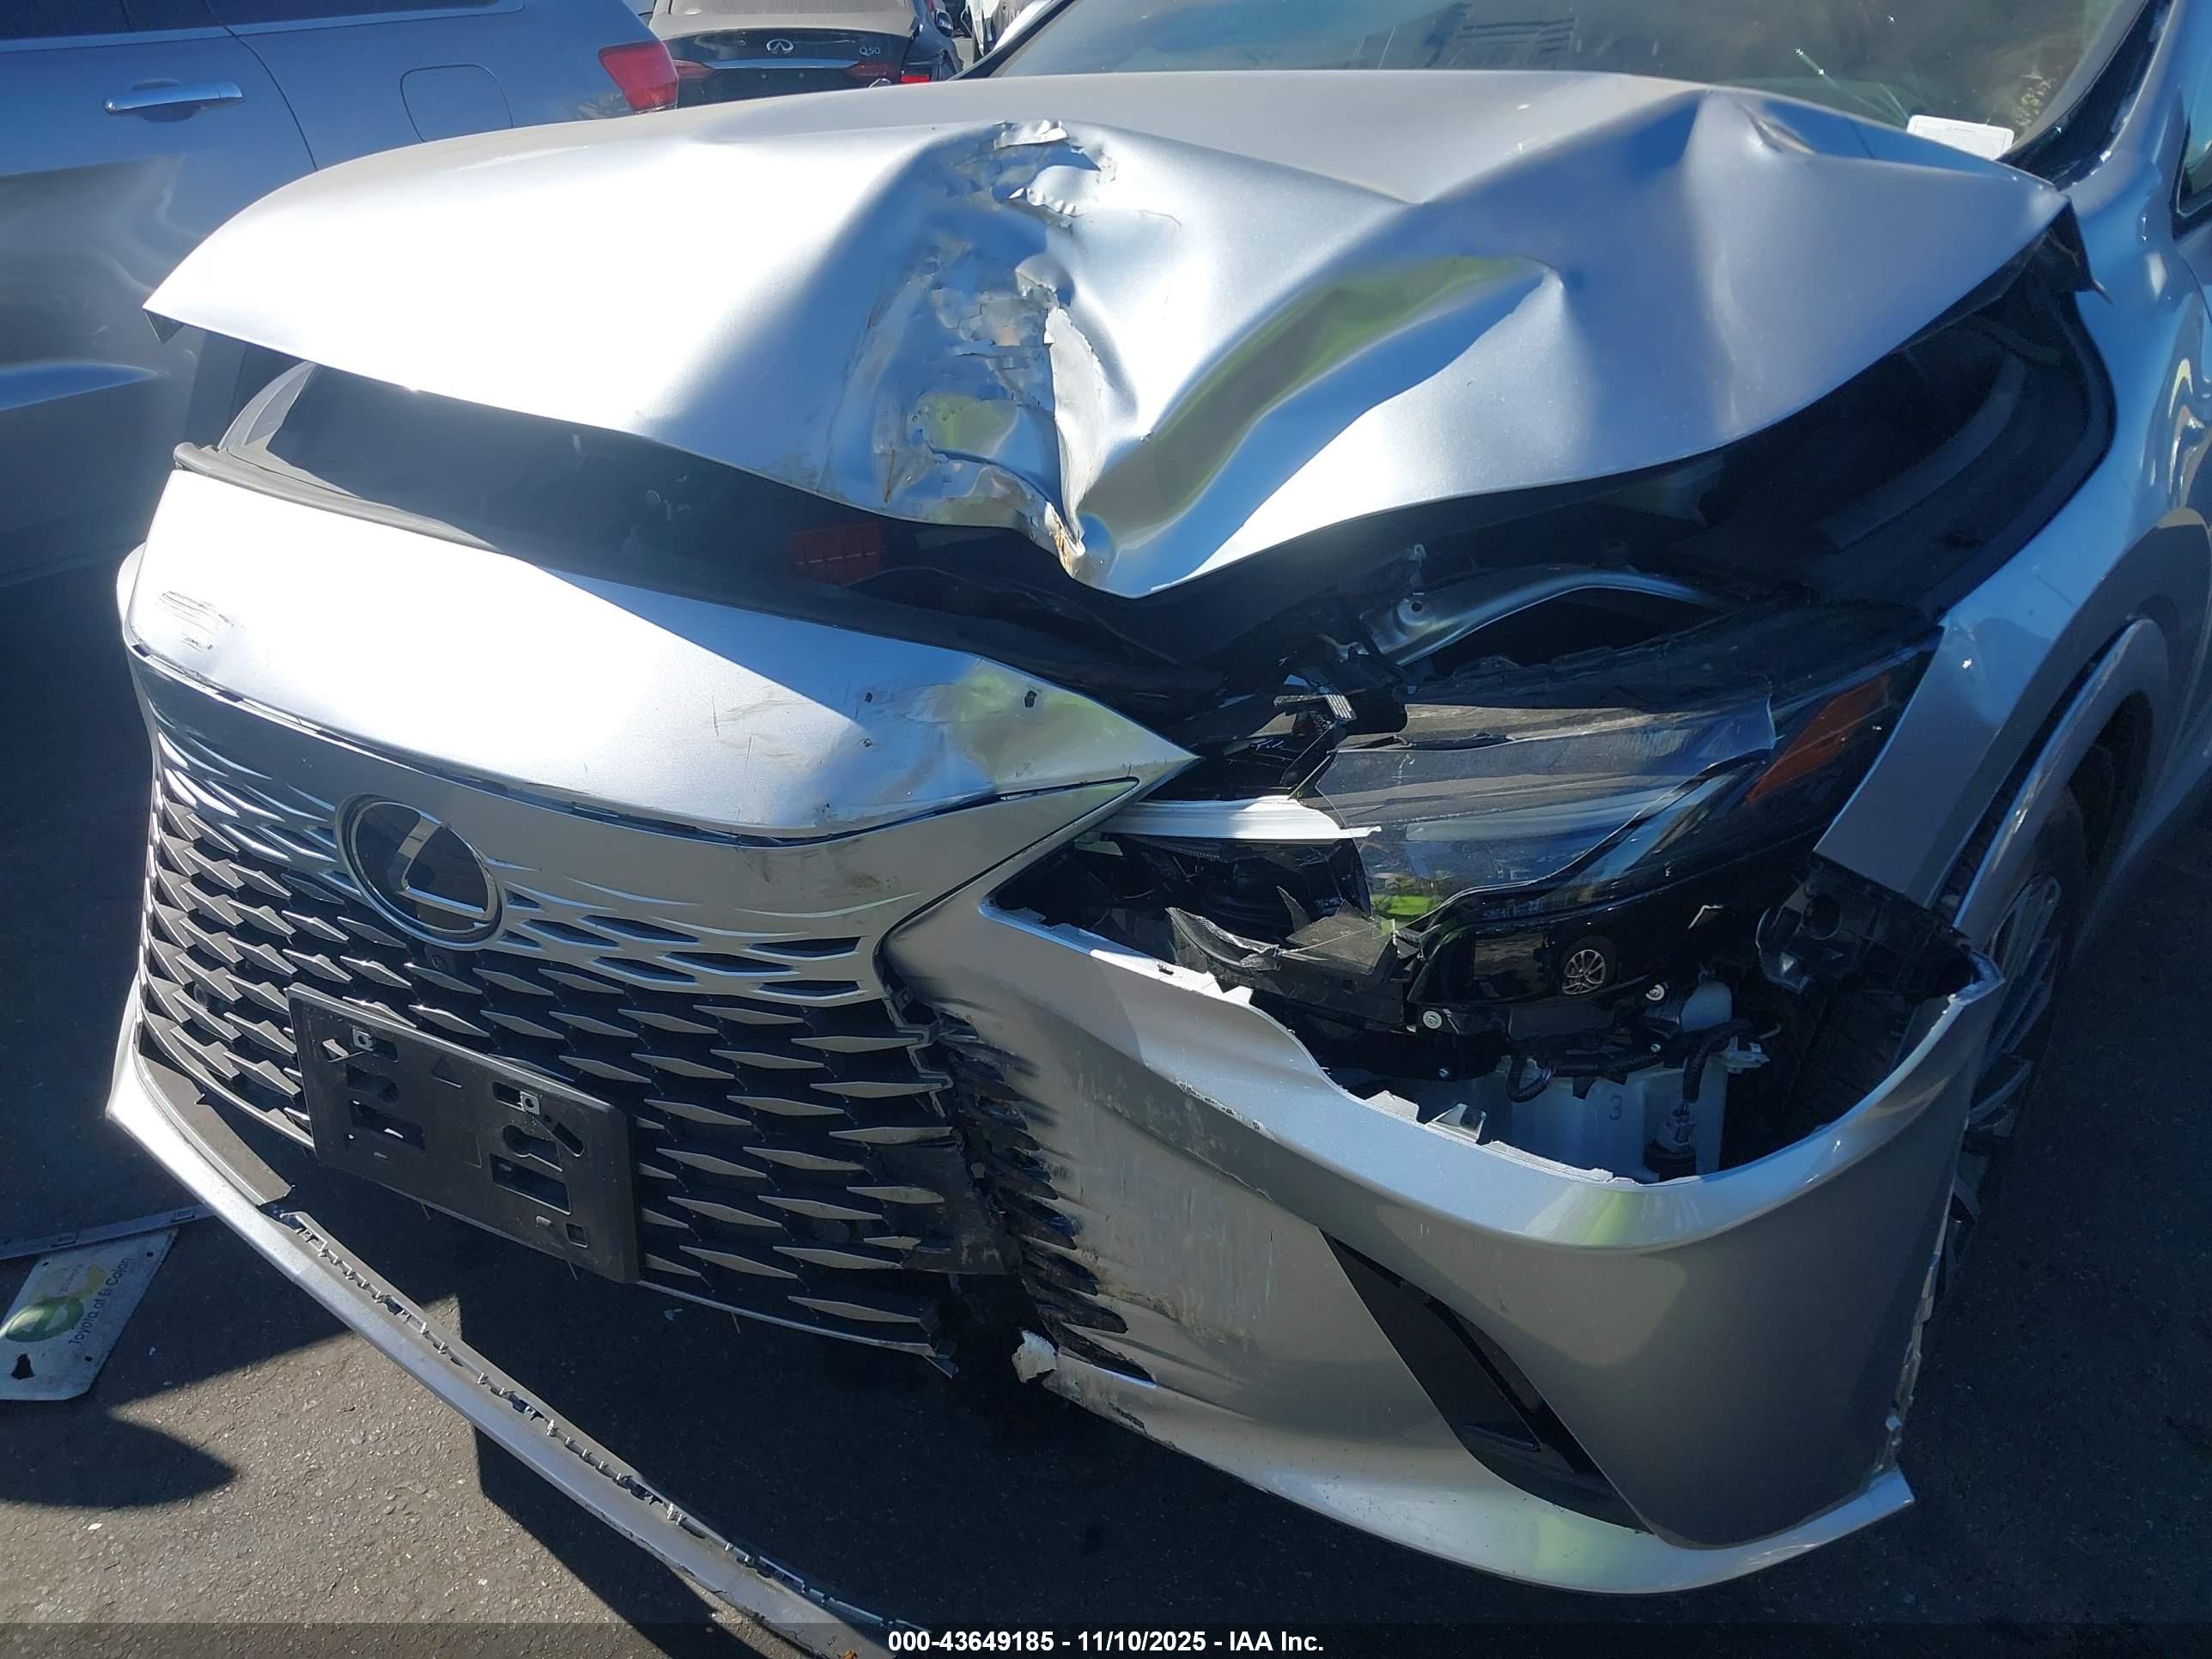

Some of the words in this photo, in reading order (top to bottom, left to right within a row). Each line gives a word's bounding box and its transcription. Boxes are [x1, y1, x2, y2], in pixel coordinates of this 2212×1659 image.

[859, 47, 880, 56] Q50
[1608, 1094, 1623, 1121] 3
[106, 1257, 132, 1285] Cajon
[99, 1288, 113, 1297] El
[94, 1298, 107, 1310] of
[69, 1311, 99, 1346] Toyota
